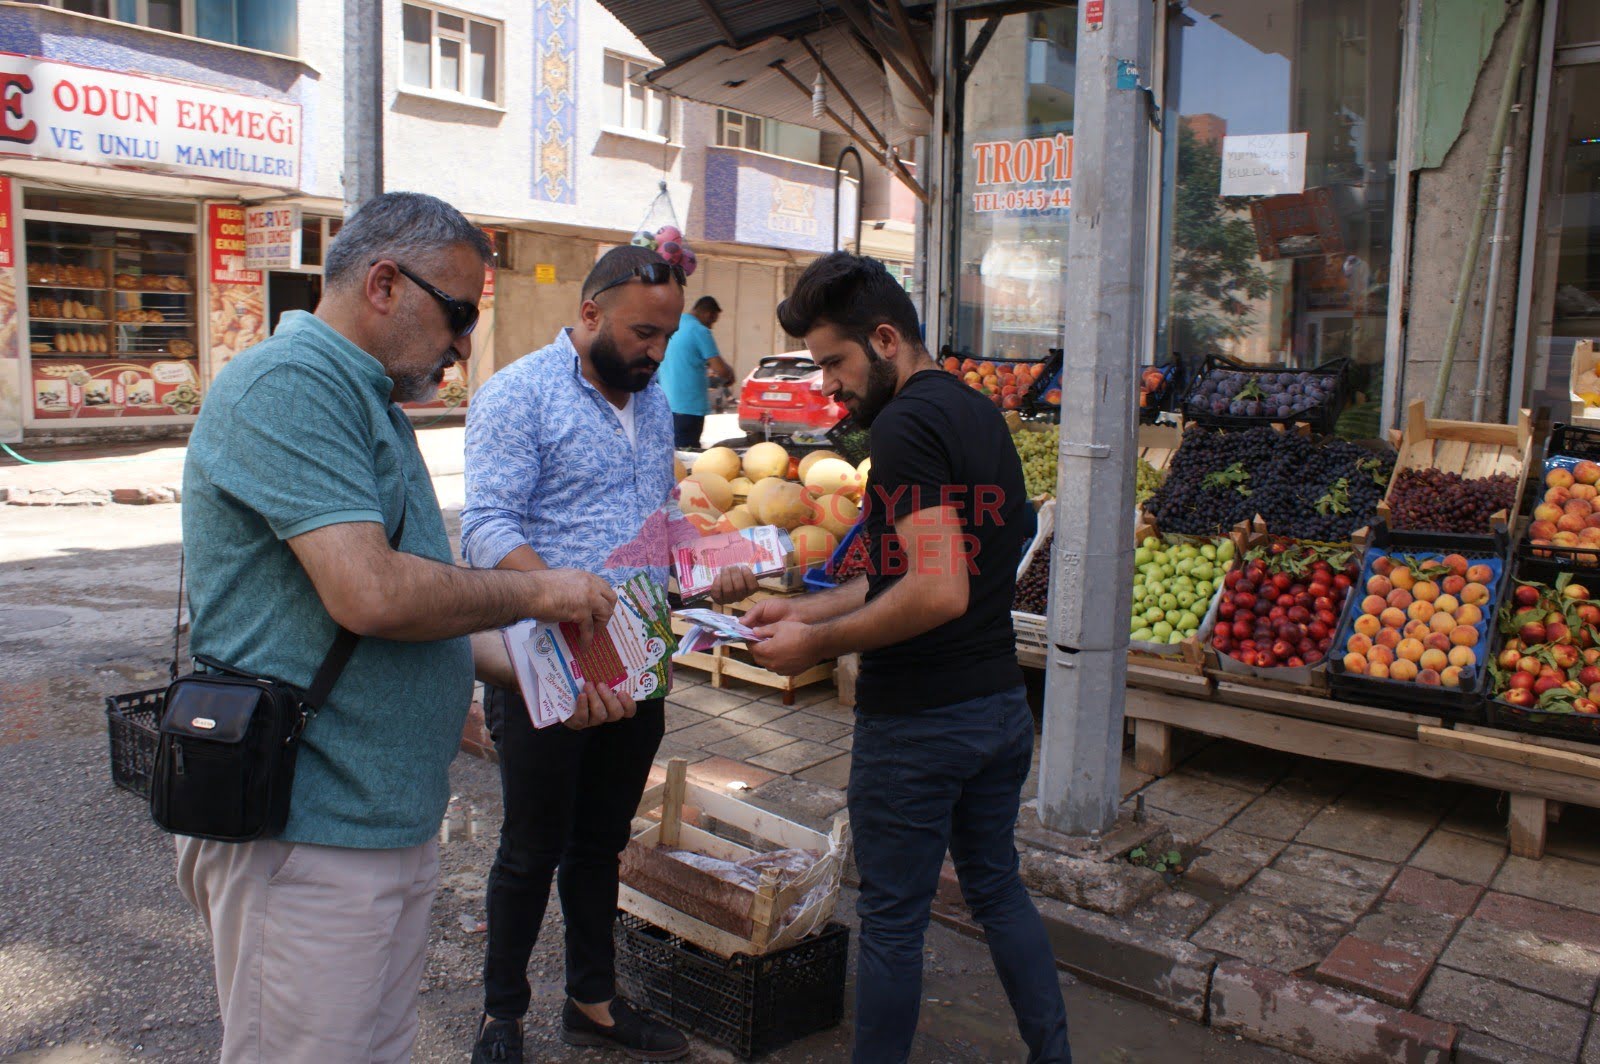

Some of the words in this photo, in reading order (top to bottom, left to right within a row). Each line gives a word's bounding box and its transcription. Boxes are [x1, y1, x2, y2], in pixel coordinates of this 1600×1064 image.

[53, 79, 157, 125] ODUN
[50, 127, 83, 150] VE
[99, 134, 159, 160] UNLU
[217, 208, 246, 220] MER
[221, 224, 245, 235] ODU
[216, 239, 246, 251] EKME
